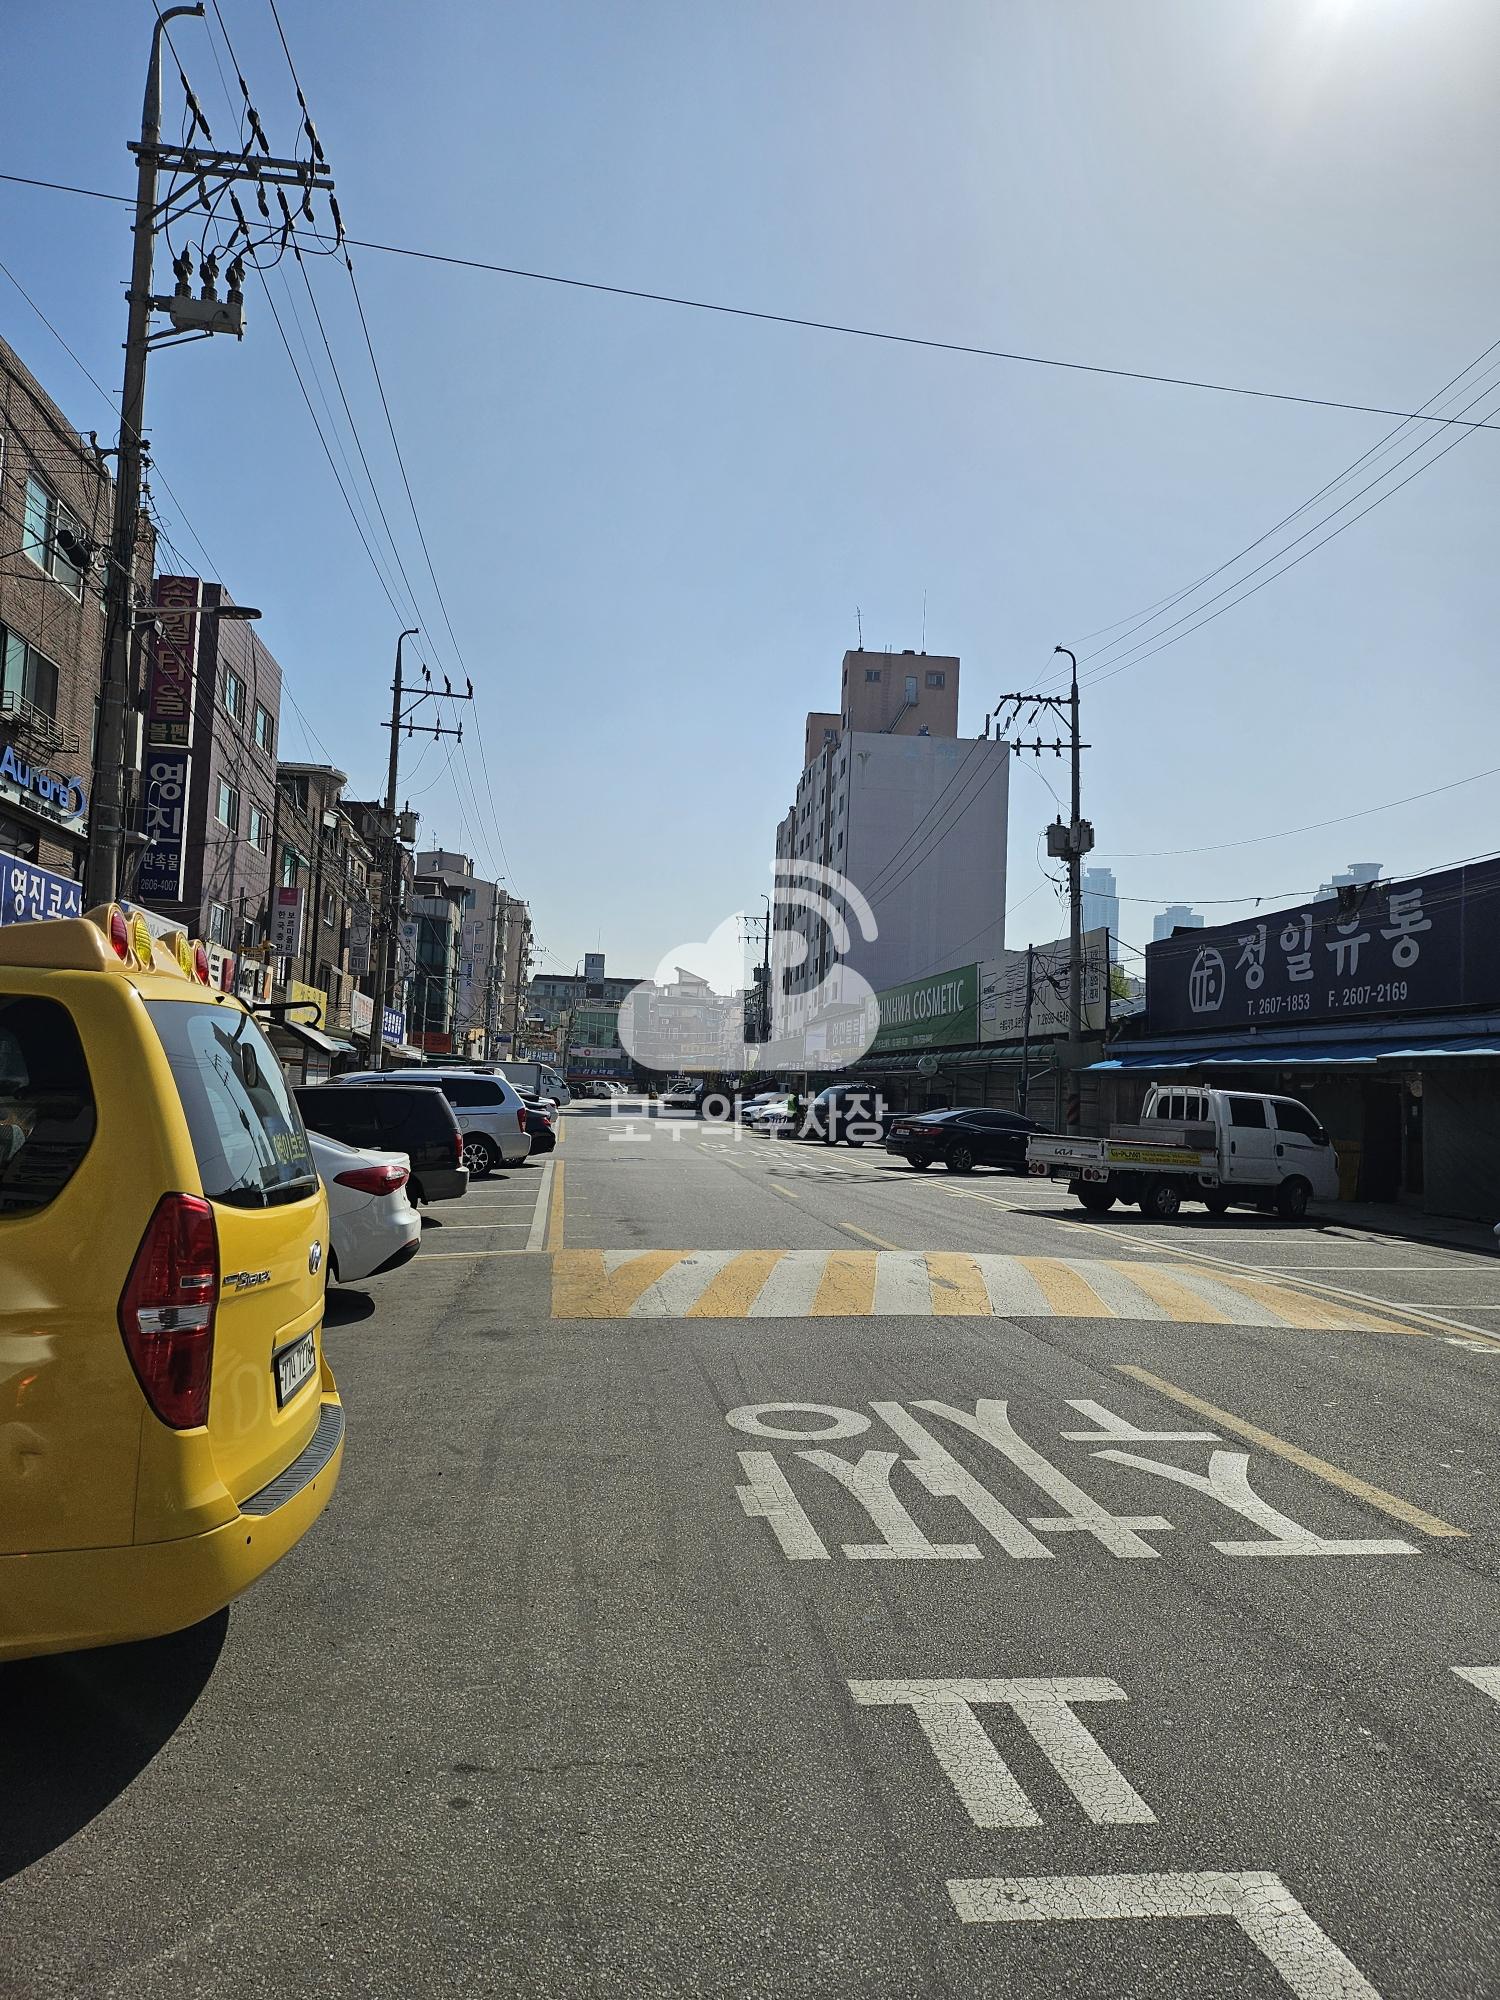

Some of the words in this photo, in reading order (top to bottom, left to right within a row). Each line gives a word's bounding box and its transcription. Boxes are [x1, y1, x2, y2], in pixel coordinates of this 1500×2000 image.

[0, 745, 70, 809] Aurora
[147, 762, 184, 843] 영진
[140, 878, 178, 892] 2606-4007
[143, 852, 180, 871] 판촉물
[1234, 888, 1433, 990] 정일유통
[873, 993, 911, 1028] SHINHWA
[913, 980, 964, 1020] COSMETIC
[1259, 993, 1311, 1015] 2607-1853
[1343, 981, 1408, 1006] 2607-2169
[1054, 1148, 1073, 1156] KIA
[726, 1398, 1423, 1559] 주차장
